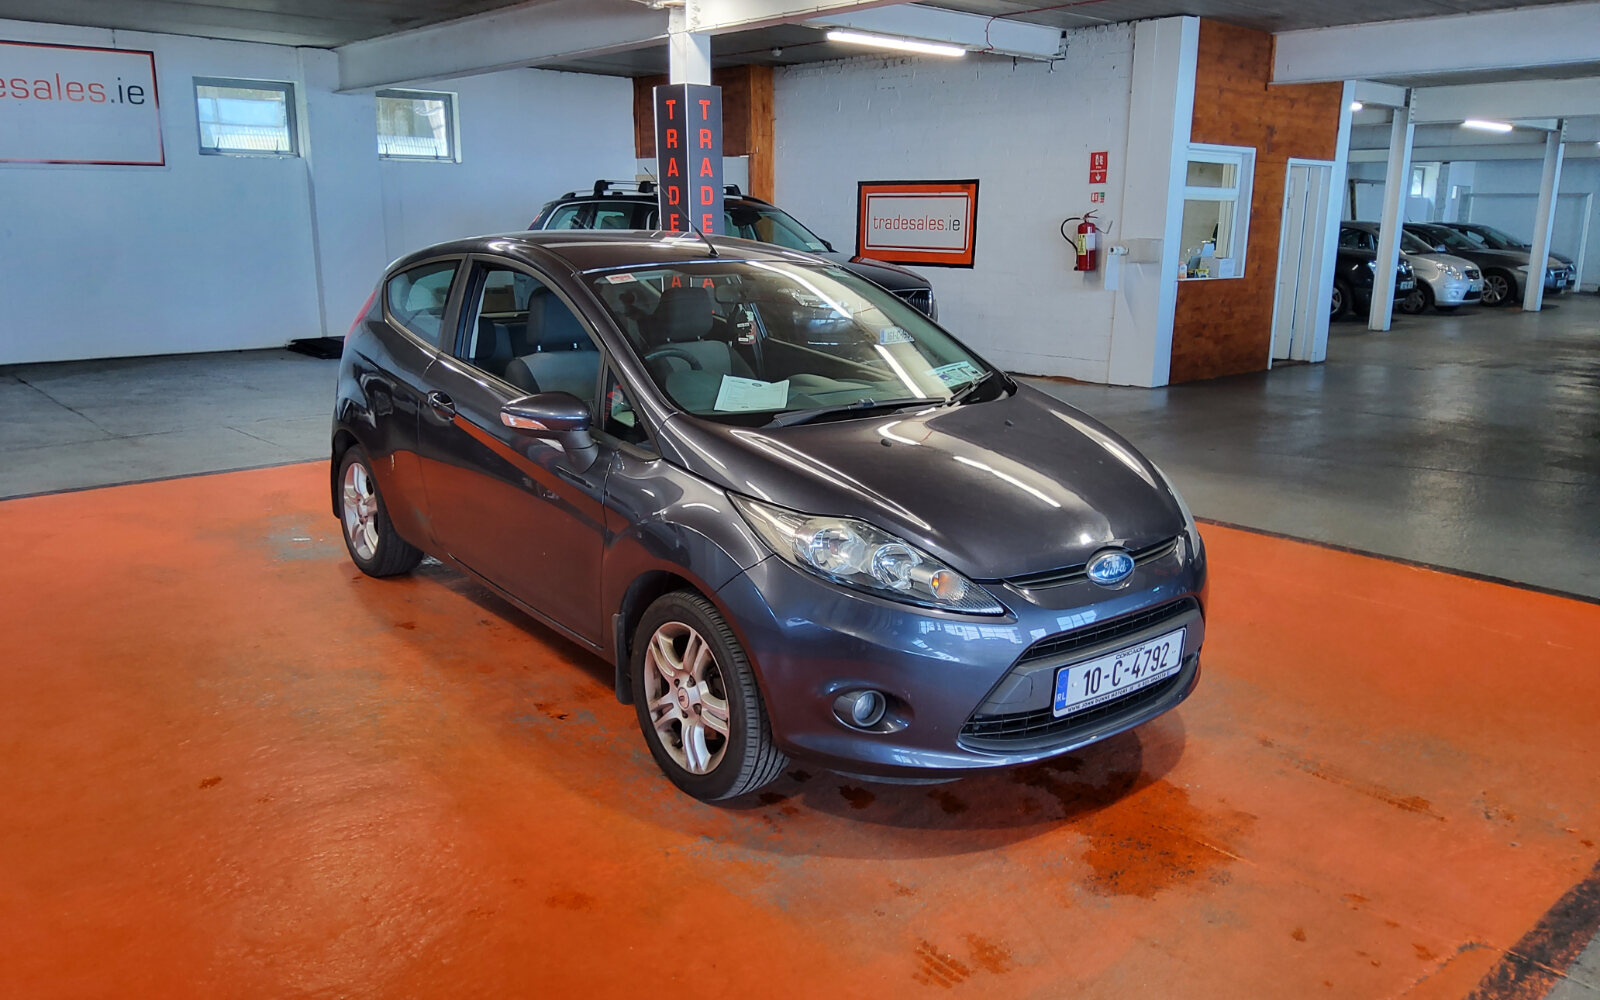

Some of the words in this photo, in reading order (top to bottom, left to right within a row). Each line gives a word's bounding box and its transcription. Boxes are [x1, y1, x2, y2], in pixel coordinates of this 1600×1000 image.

[0, 73, 145, 105] sales.ie
[698, 99, 714, 233] TRADE
[873, 214, 961, 231] tradesales.ie
[1083, 641, 1170, 697] 10-C-4792
